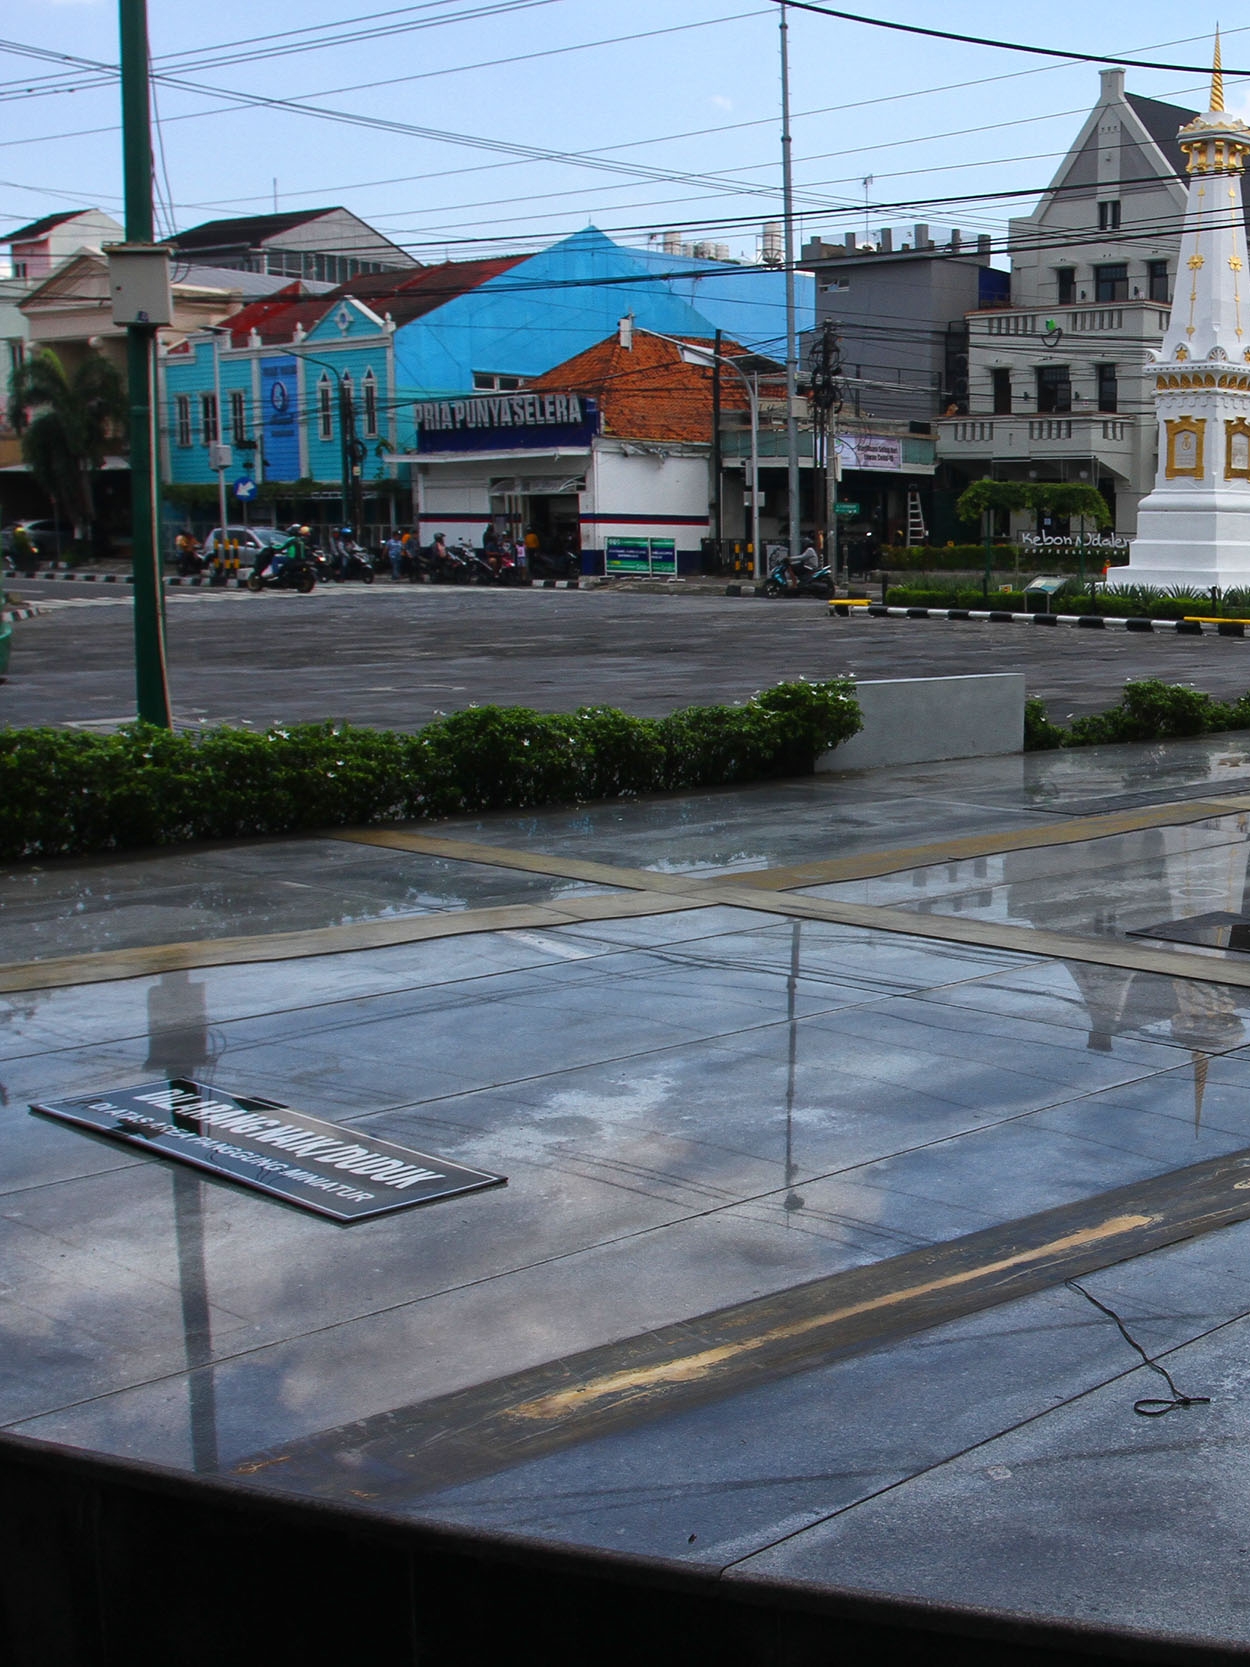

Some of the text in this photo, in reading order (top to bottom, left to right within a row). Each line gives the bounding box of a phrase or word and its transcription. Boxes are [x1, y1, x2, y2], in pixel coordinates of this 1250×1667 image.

[414, 394, 582, 431] PRIA PUNYA SELERA
[1021, 528, 1073, 546] Kebon
[88, 1102, 375, 1202] DI ATAS AREA PANGGUNG MINIATUR
[134, 1089, 446, 1189] DILARANG NAIK/DUDUK
